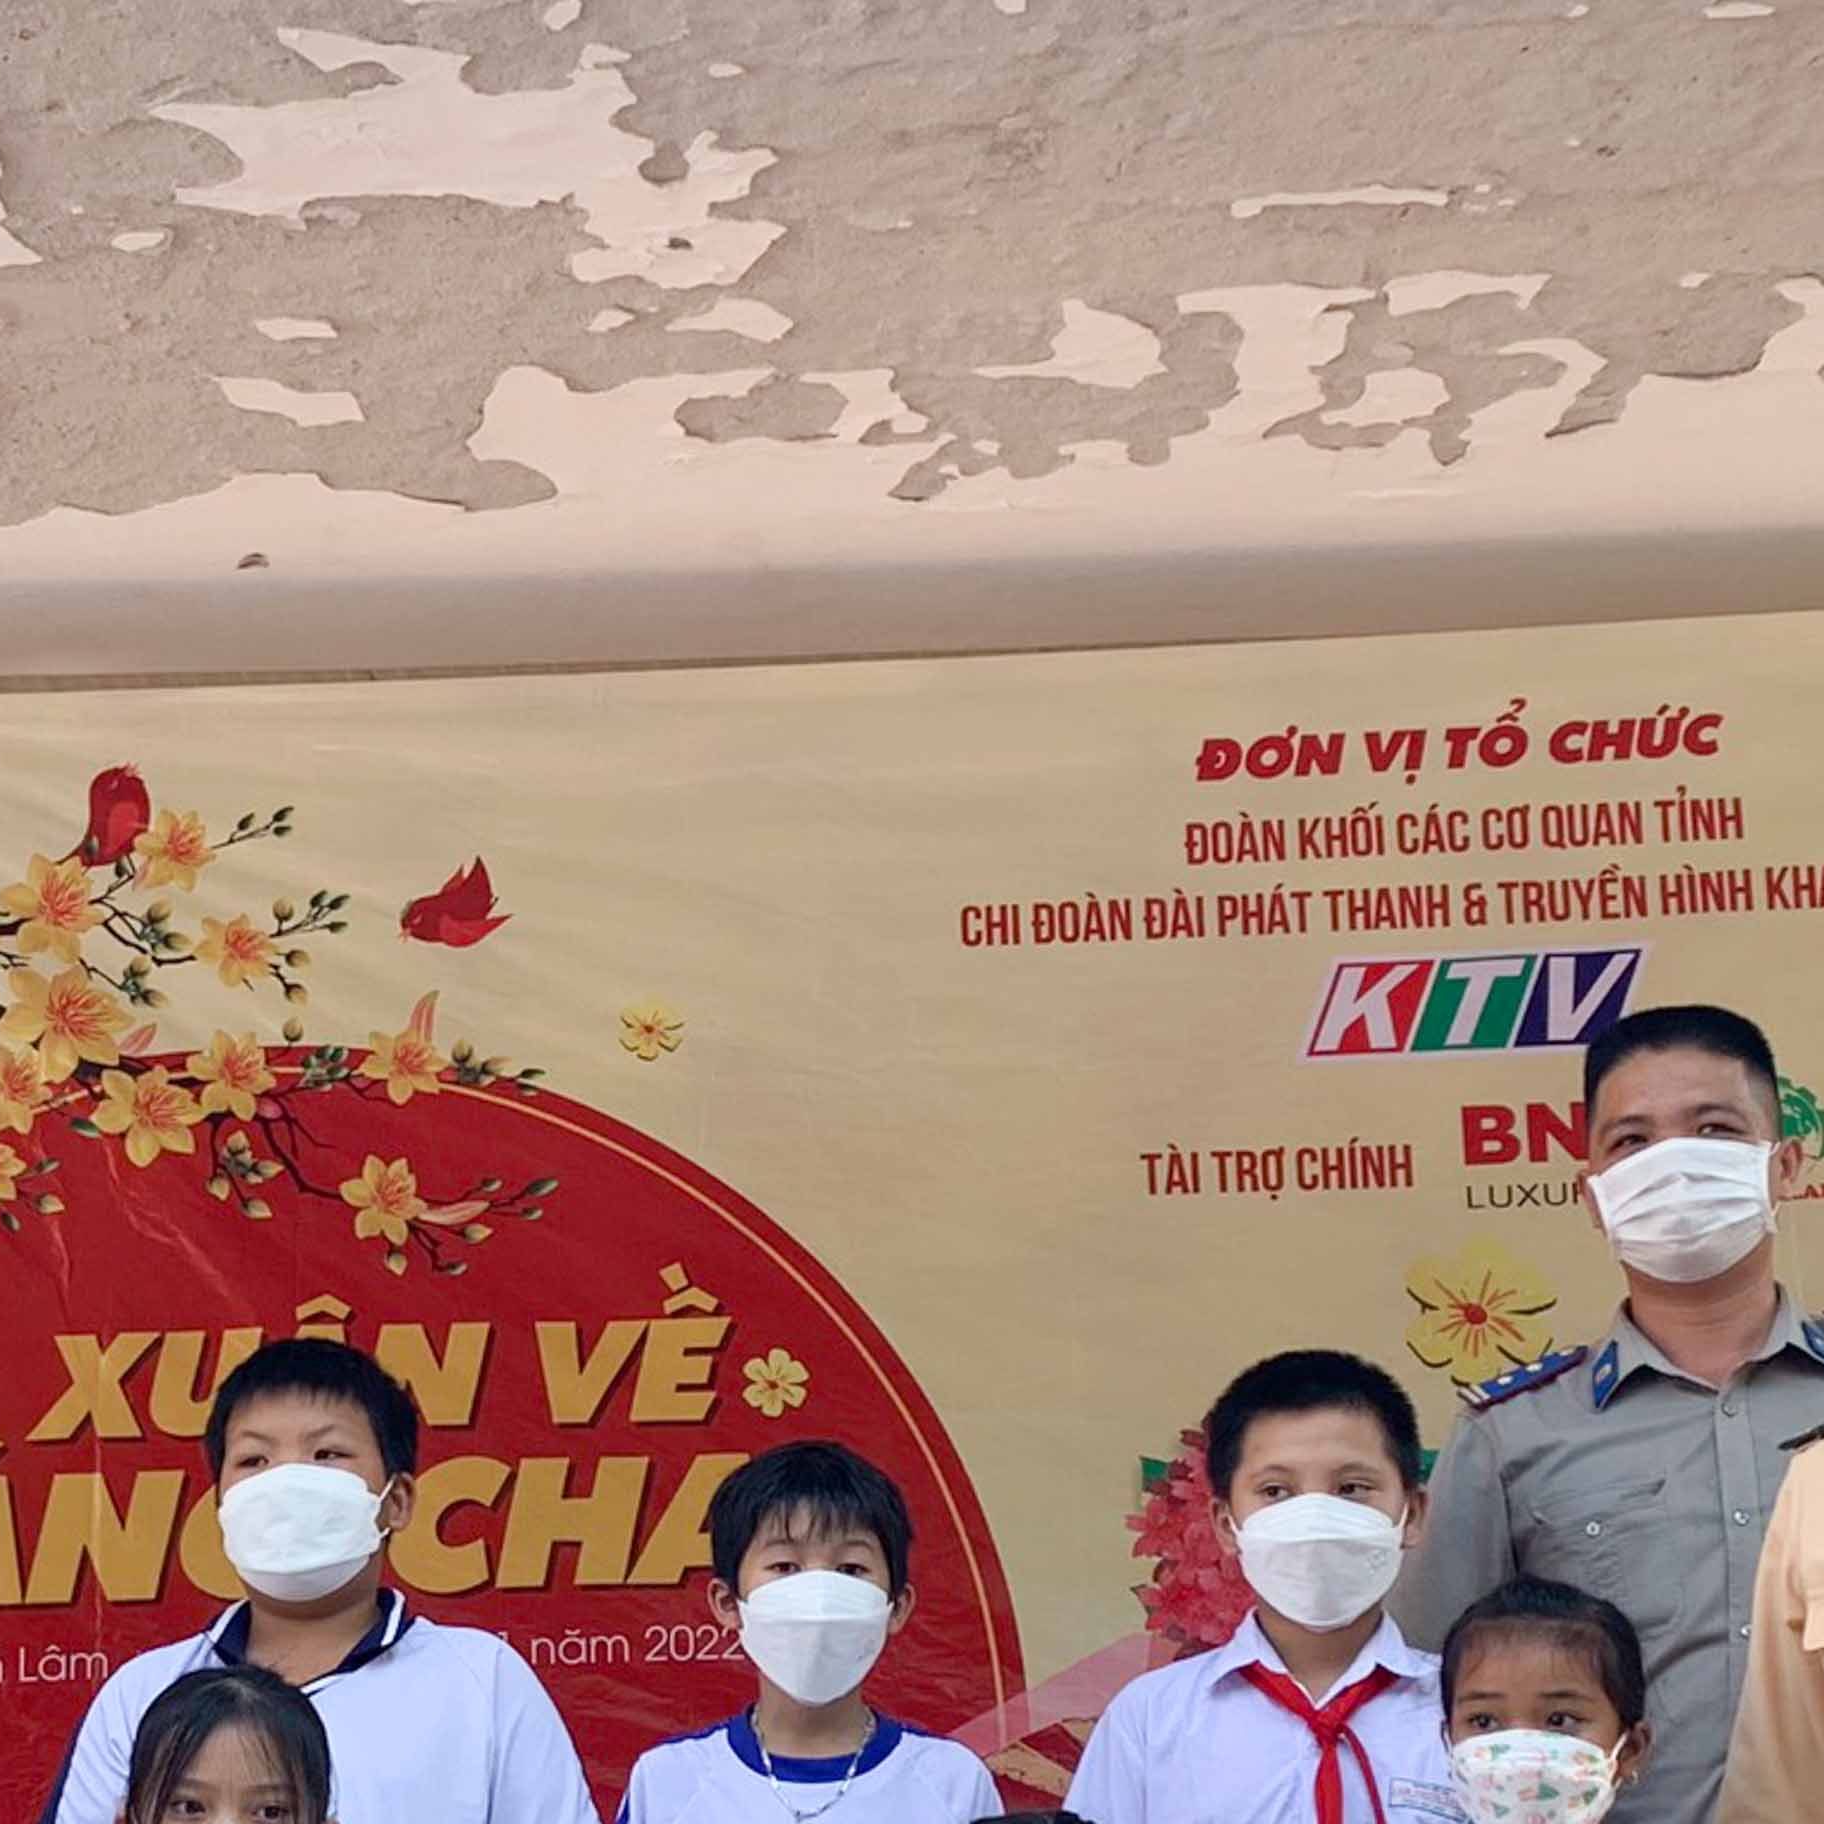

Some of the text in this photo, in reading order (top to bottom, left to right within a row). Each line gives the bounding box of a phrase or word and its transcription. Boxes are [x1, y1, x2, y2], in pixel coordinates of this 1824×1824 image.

[1195, 699, 1725, 784] ĐƠN VỊ TỔ CHỨC
[1185, 787, 1745, 866] ĐOÀN KHỐI CÁC CƠ QUAN TỈNH
[961, 907, 1023, 947] CHI
[1032, 894, 1134, 946] ĐOÀN
[1145, 888, 1207, 940] ĐÀI
[1218, 884, 1312, 937] PHÁT
[1323, 882, 1452, 932] THANH
[1464, 887, 1488, 928] &
[1502, 864, 1648, 922] TRUYỀN
[1662, 860, 1755, 917] HÌNH
[1315, 953, 1631, 1053] KTV
[1142, 1142, 1413, 1196] TÀI TRỢ CHÍNH
[1461, 1103, 1590, 1168] BN
[534, 1263, 734, 1426] VỀ
[19, 1643, 109, 1682] Lâm
[530, 1628, 630, 1666] năm
[643, 1624, 746, 1663] 2022
